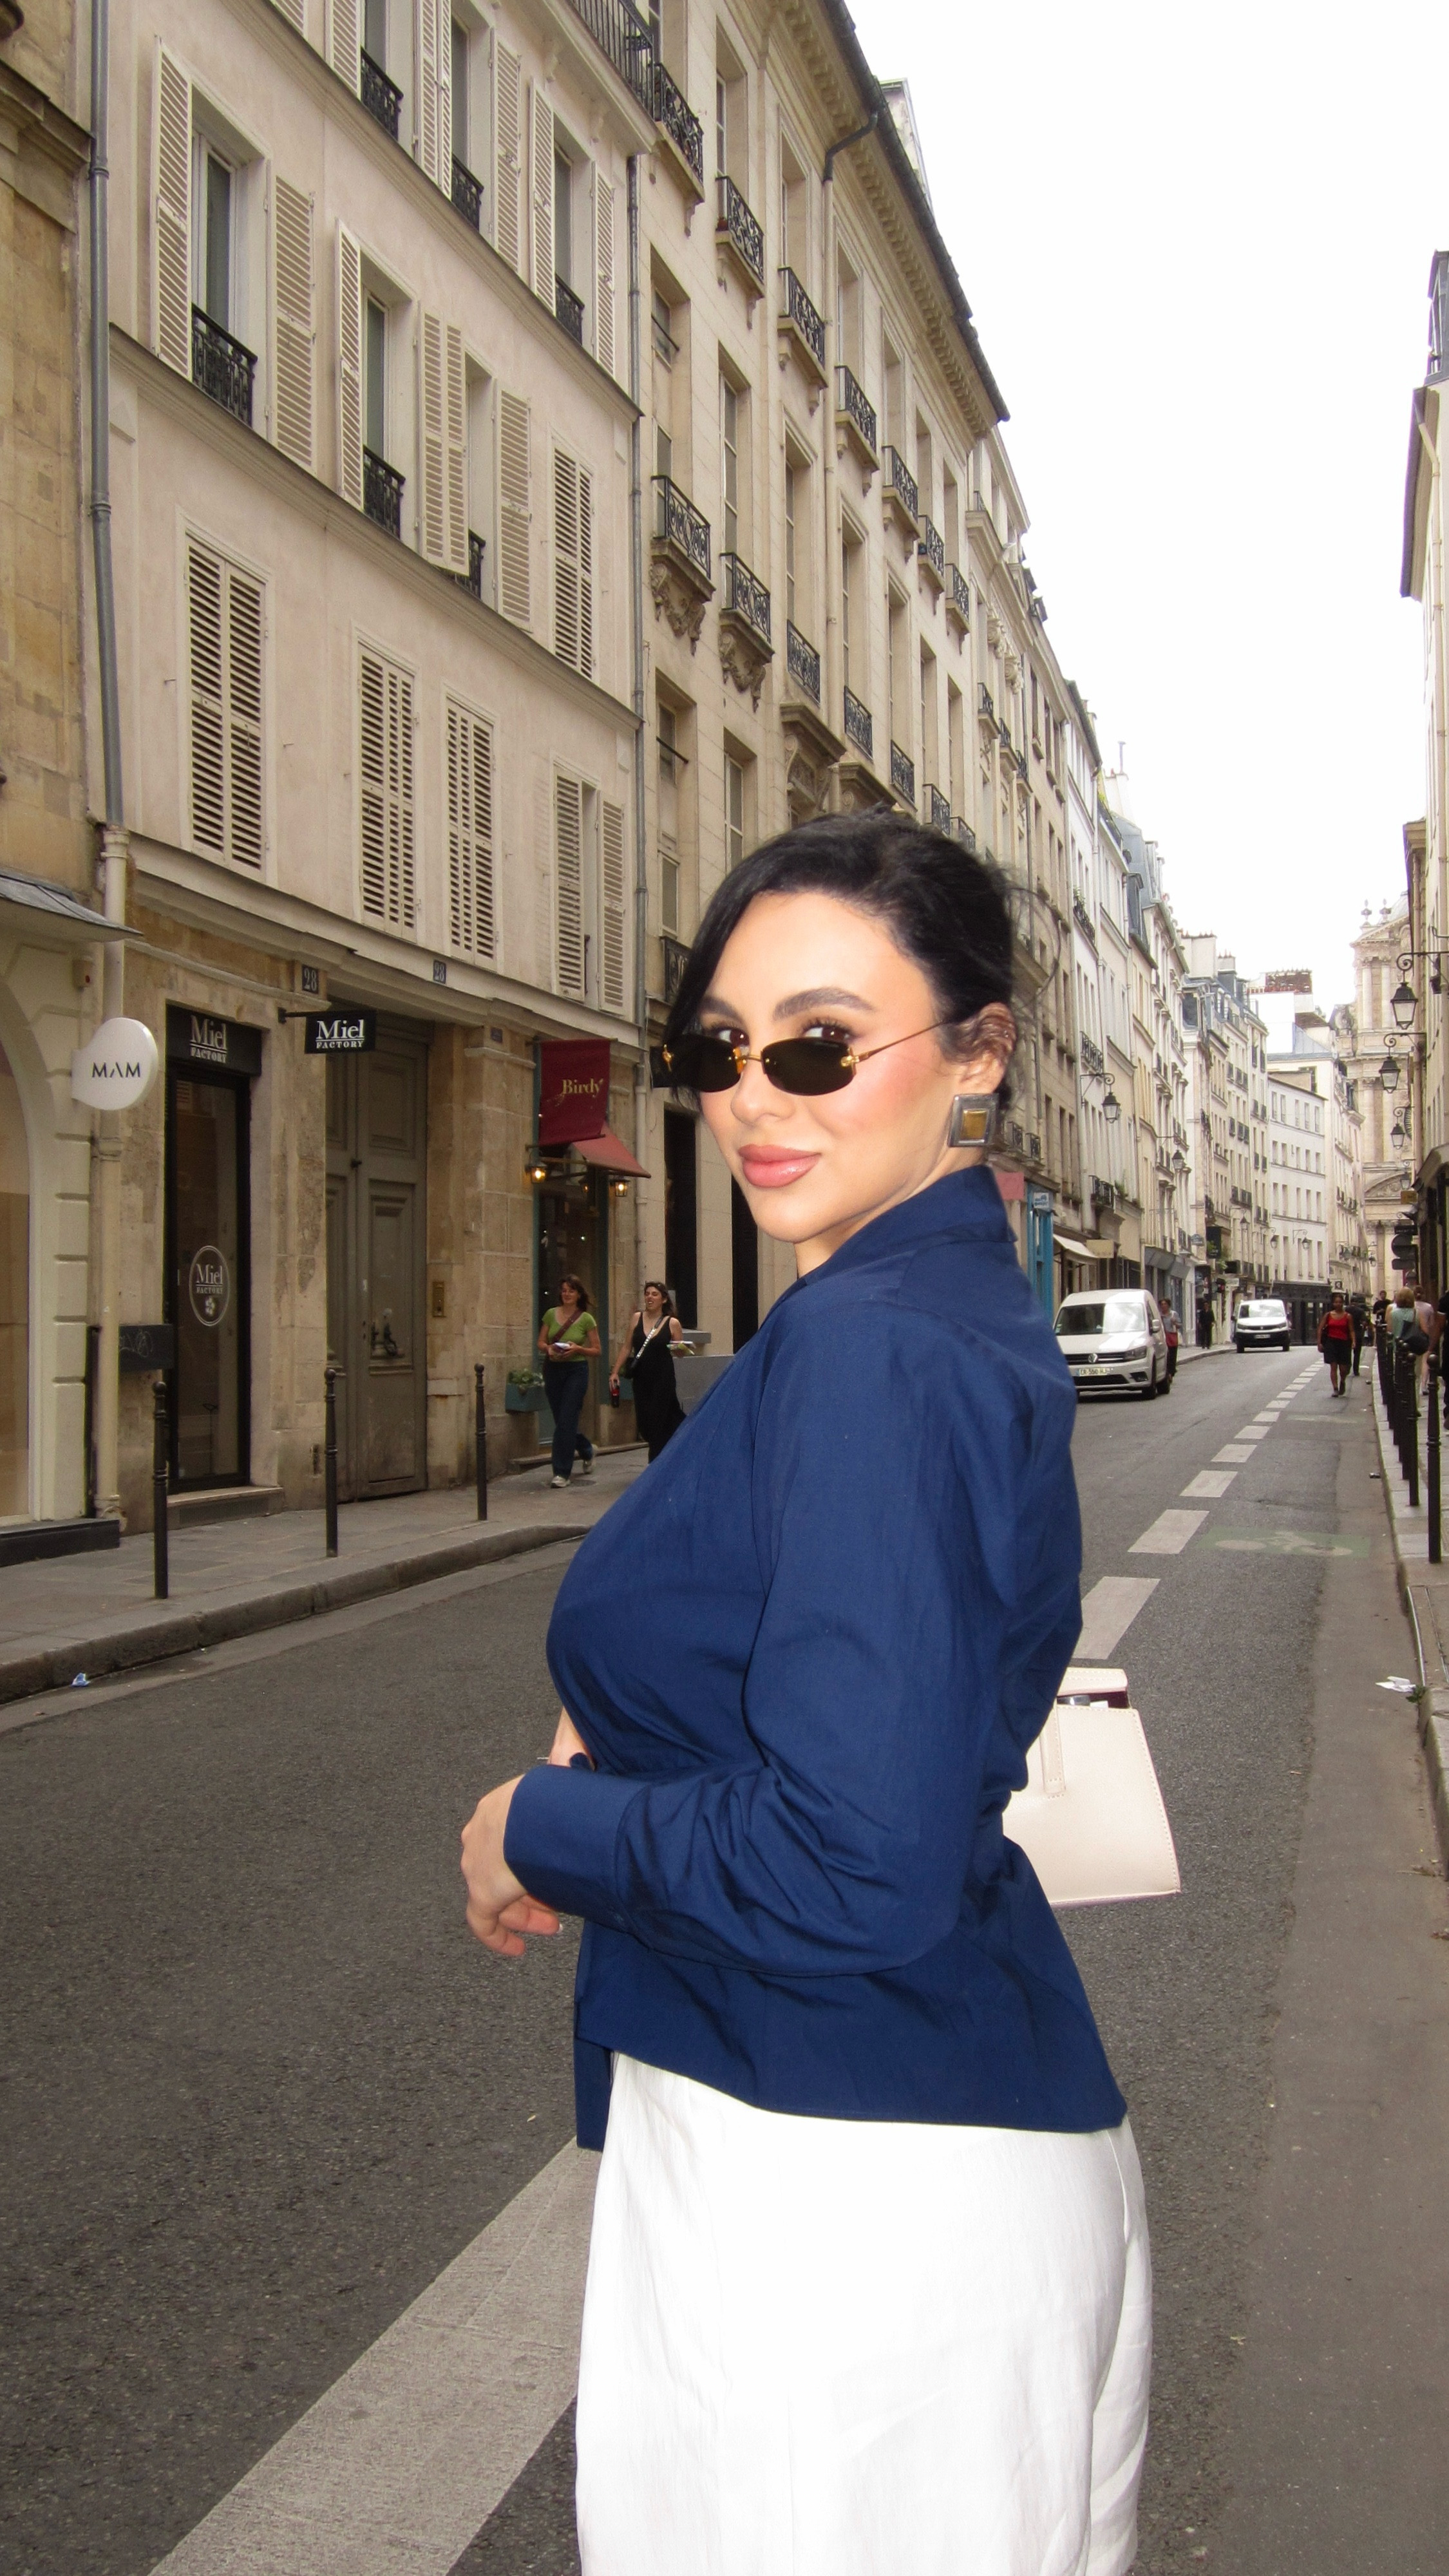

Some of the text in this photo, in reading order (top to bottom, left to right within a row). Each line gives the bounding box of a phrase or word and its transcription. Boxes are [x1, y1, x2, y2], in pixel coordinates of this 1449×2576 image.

[304, 968, 317, 991] 28
[434, 962, 444, 982] 28
[189, 1015, 227, 1050] Miel
[316, 1019, 365, 1039] Miel
[191, 1047, 226, 1063] FACTORY
[92, 1062, 140, 1078] MAM
[562, 1077, 603, 1097] Birdy
[196, 1264, 223, 1284] Miel
